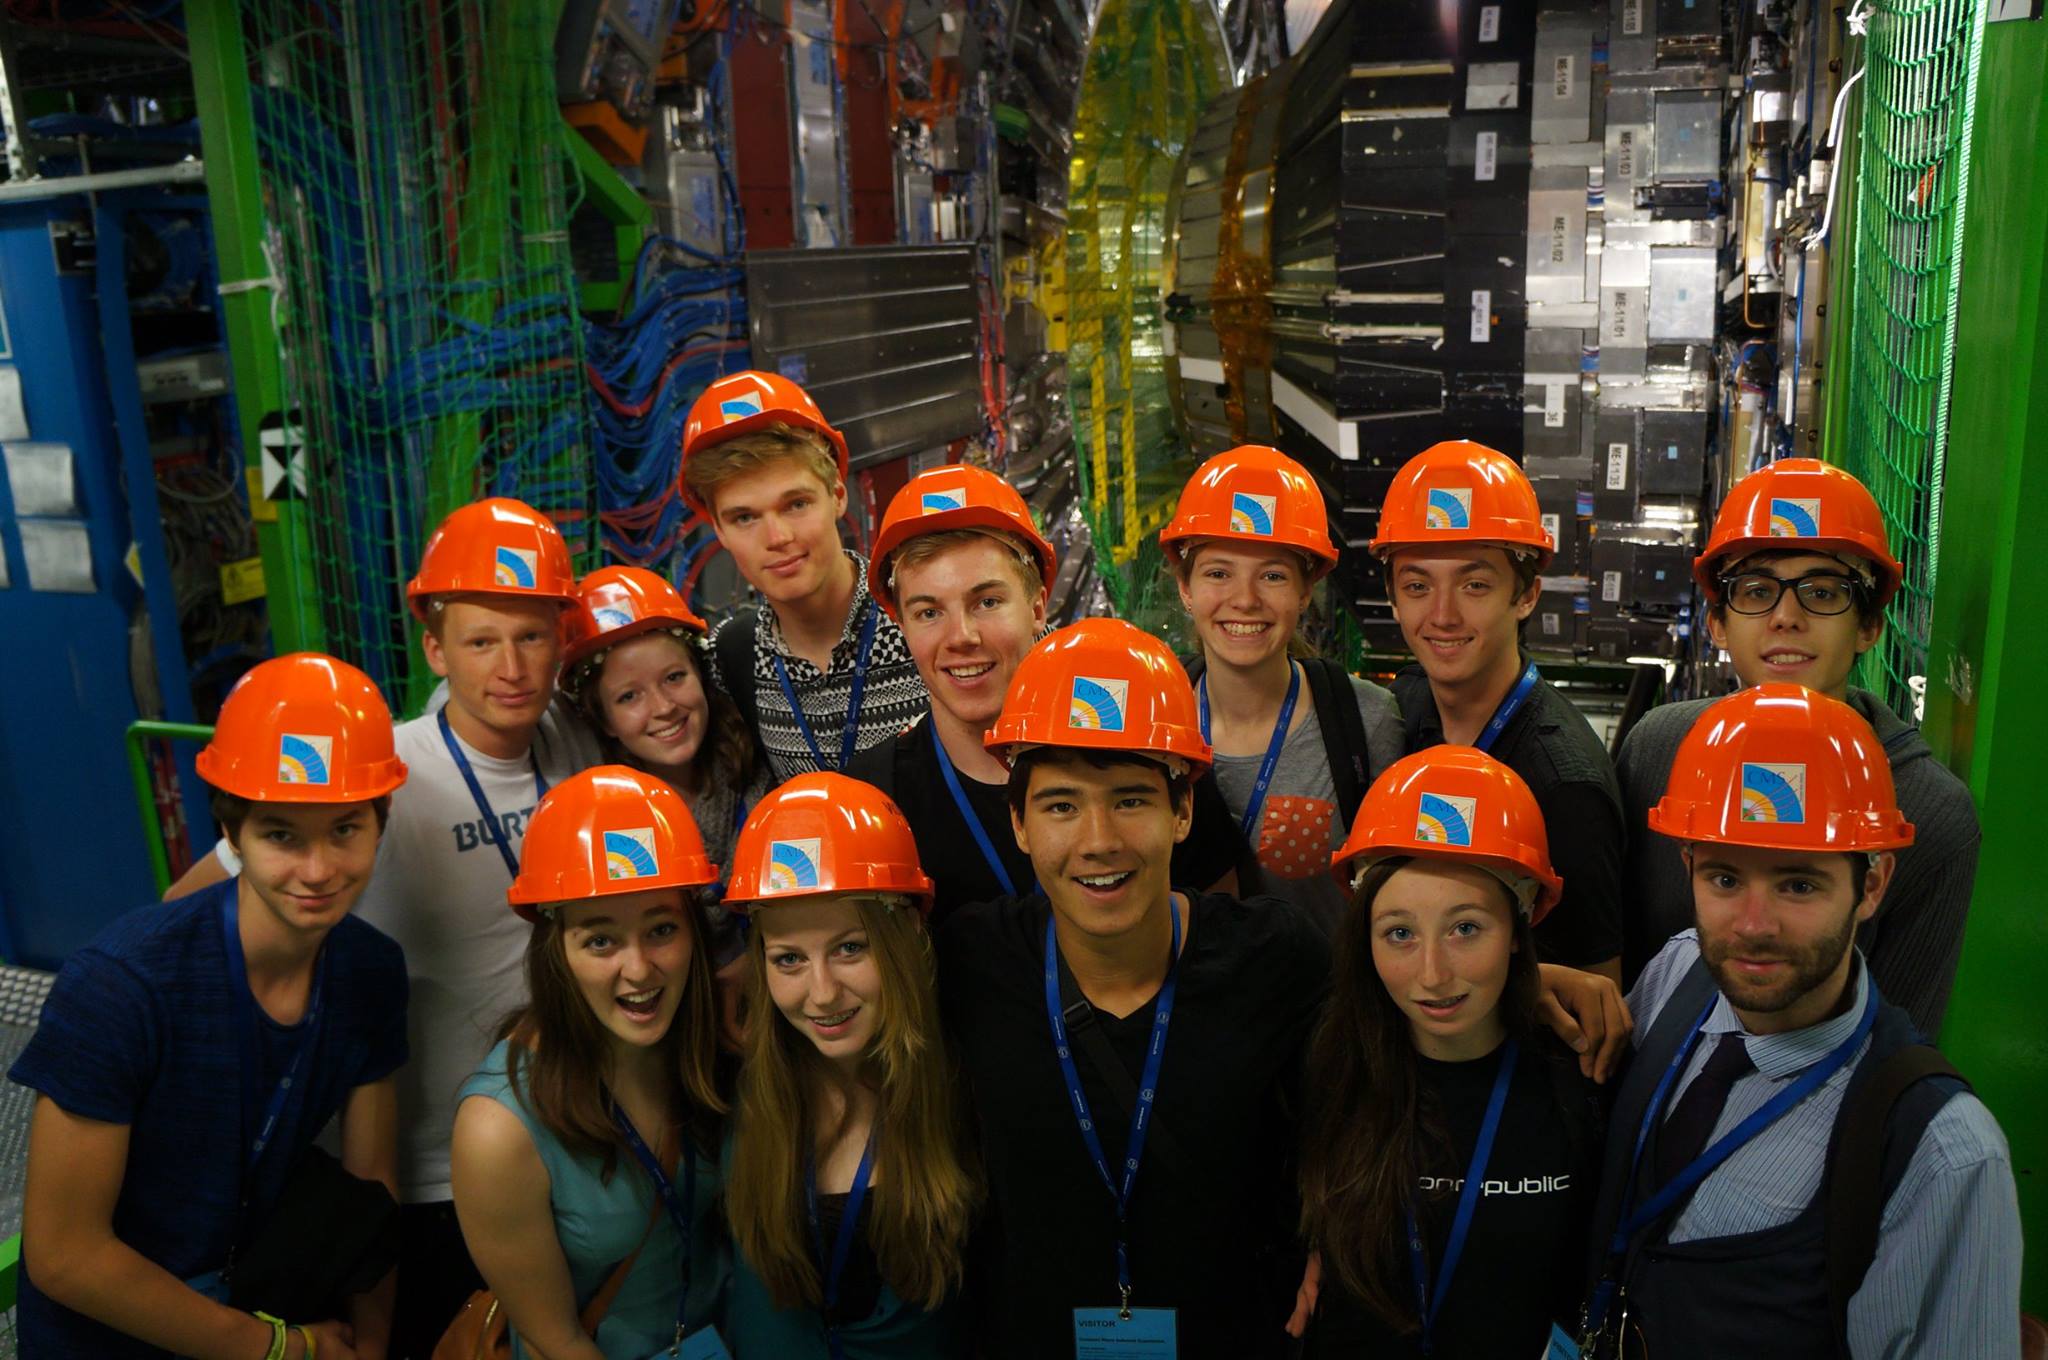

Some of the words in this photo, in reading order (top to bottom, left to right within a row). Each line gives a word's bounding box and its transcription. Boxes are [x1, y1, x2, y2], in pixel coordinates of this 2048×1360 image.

[1077, 683, 1112, 698] CMS
[1747, 771, 1787, 787] CMS
[1424, 798, 1460, 812] CMS
[451, 805, 537, 853] BURT
[1078, 1319, 1117, 1329] VISITOR
